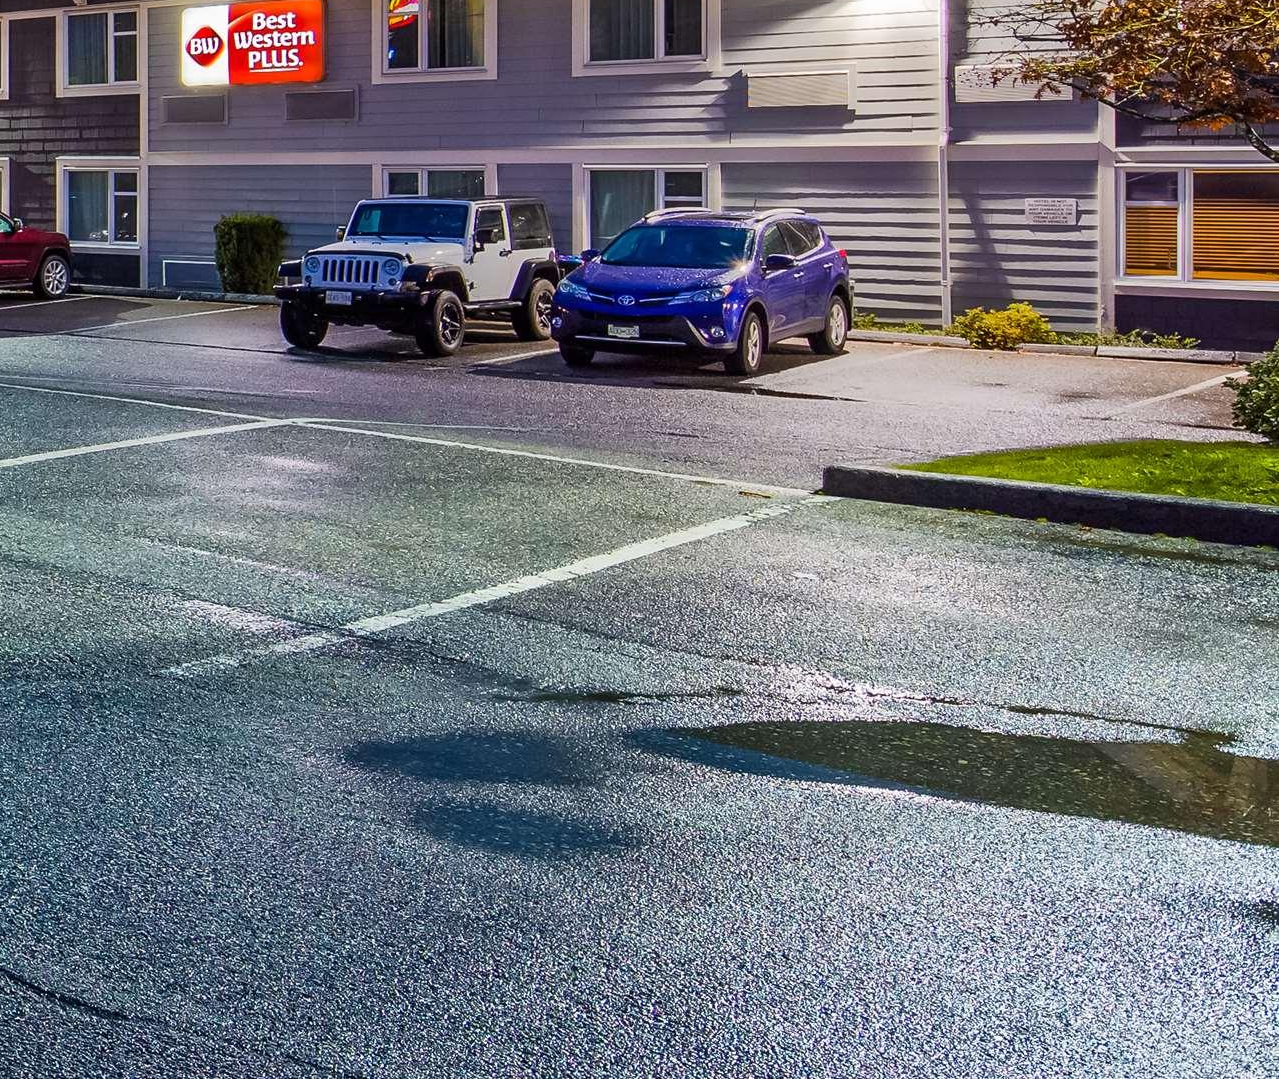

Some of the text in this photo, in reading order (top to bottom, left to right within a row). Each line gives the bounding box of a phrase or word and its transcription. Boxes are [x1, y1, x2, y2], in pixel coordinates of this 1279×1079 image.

[252, 12, 296, 30] Best
[190, 37, 219, 55] BW
[233, 30, 315, 49] Western
